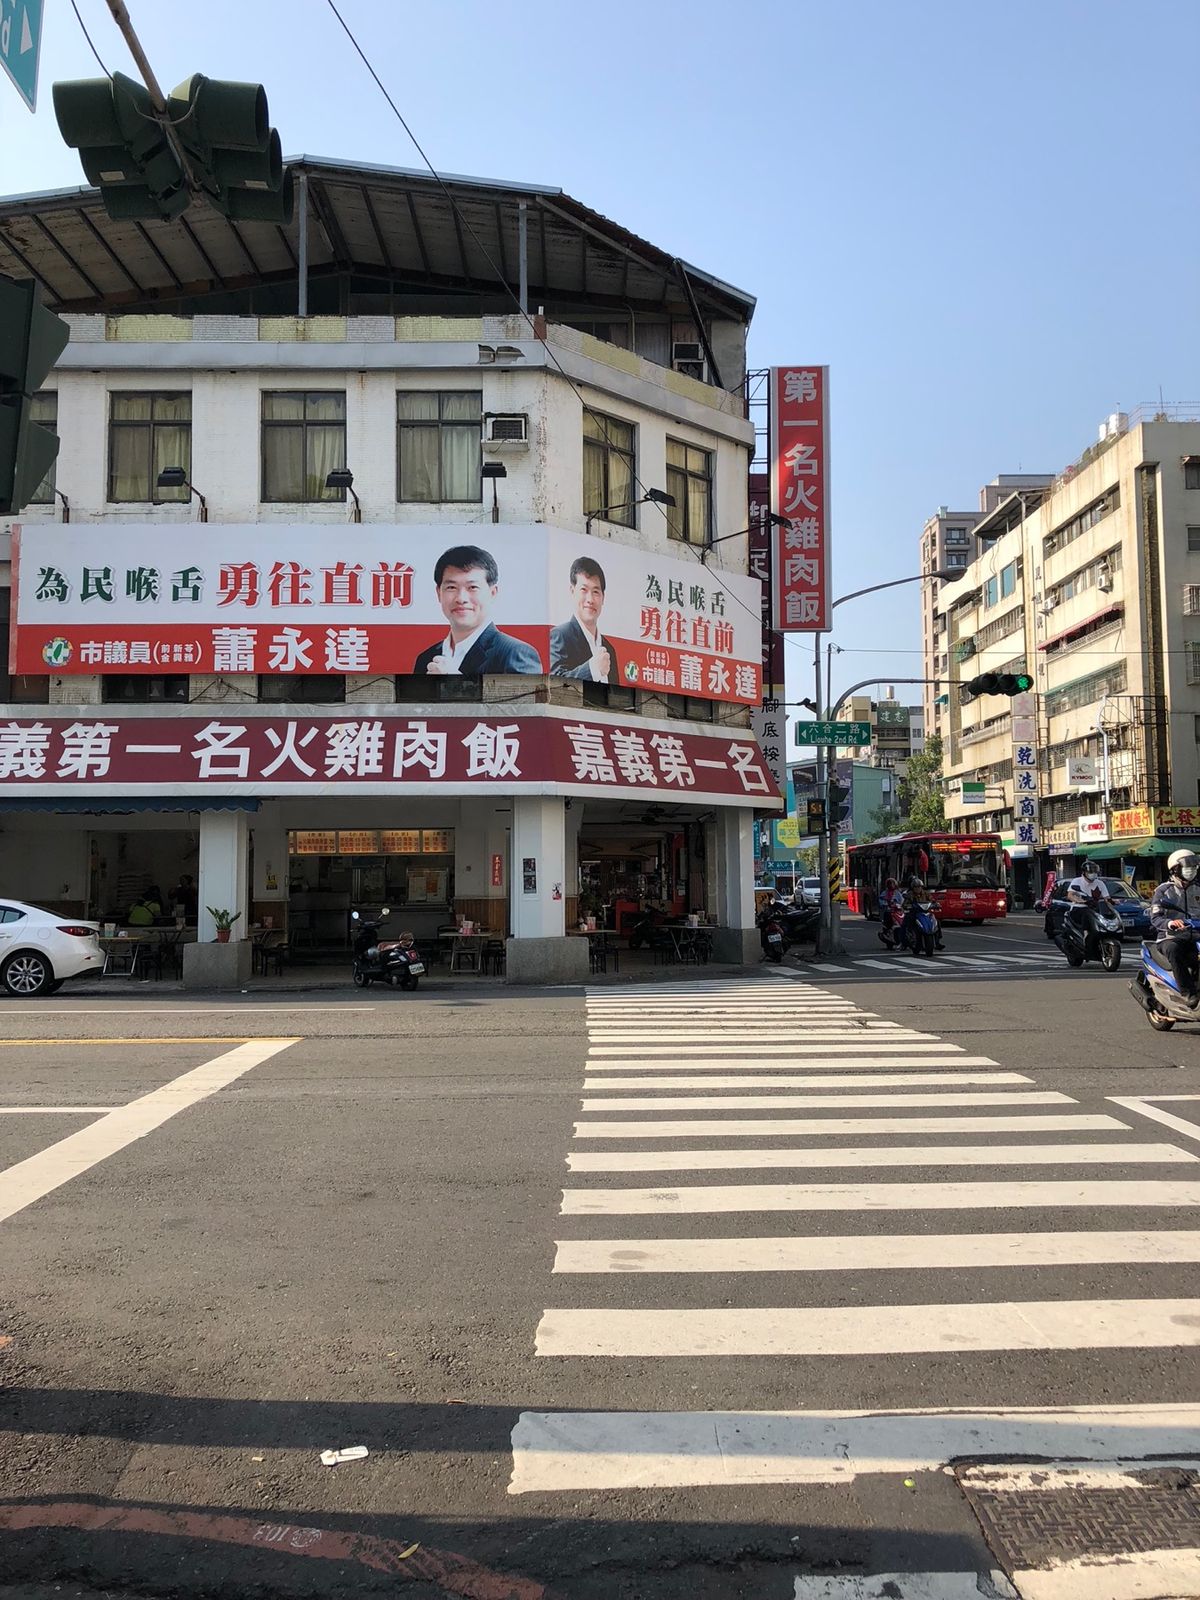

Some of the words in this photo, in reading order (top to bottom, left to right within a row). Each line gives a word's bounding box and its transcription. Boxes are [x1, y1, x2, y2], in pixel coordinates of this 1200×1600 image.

[783, 371, 820, 624] 第一名火雞肉飯
[36, 566, 203, 604] 為民喉舌
[216, 561, 416, 608] 勇往直前
[645, 574, 726, 617] 為民喉舌
[80, 641, 151, 665] 市議員
[212, 626, 371, 672] 蕭永達
[640, 605, 734, 654] 勇往直前
[679, 654, 758, 700] 蕭永達
[809, 723, 861, 734] 六合二路
[834, 735, 847, 744] 2nd
[563, 723, 770, 793] 嘉義第一名
[1156, 808, 1200, 826] 仁發
